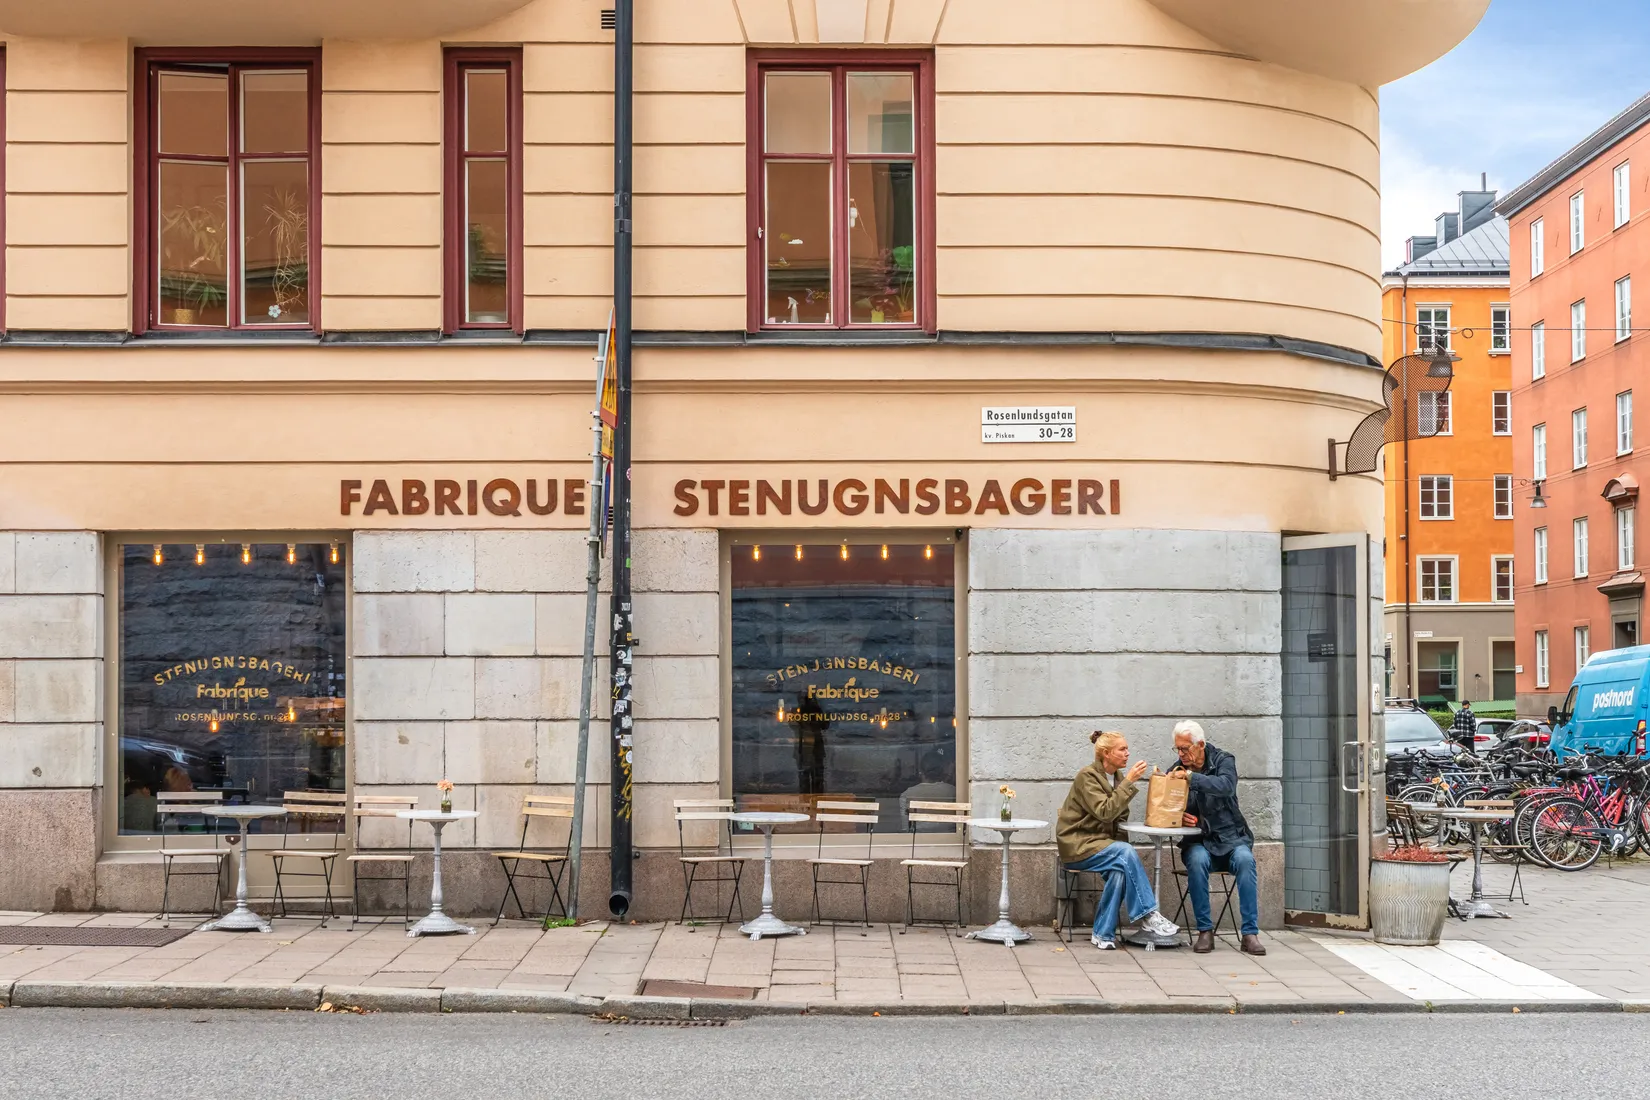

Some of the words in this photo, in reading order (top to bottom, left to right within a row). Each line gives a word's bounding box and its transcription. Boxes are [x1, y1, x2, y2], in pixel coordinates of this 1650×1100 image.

[987, 409, 1073, 422] Rosenlundsgatan
[1039, 427, 1073, 438] 30-28
[340, 478, 585, 516] FABRIQUE
[673, 477, 1120, 516] STENUGNSBAGERI
[766, 656, 920, 686] STENUGNSBAGERI
[196, 677, 269, 703] Fabrique
[807, 677, 879, 703] Fabrique
[1592, 686, 1635, 712] postnord
[888, 712, 901, 721] 28
